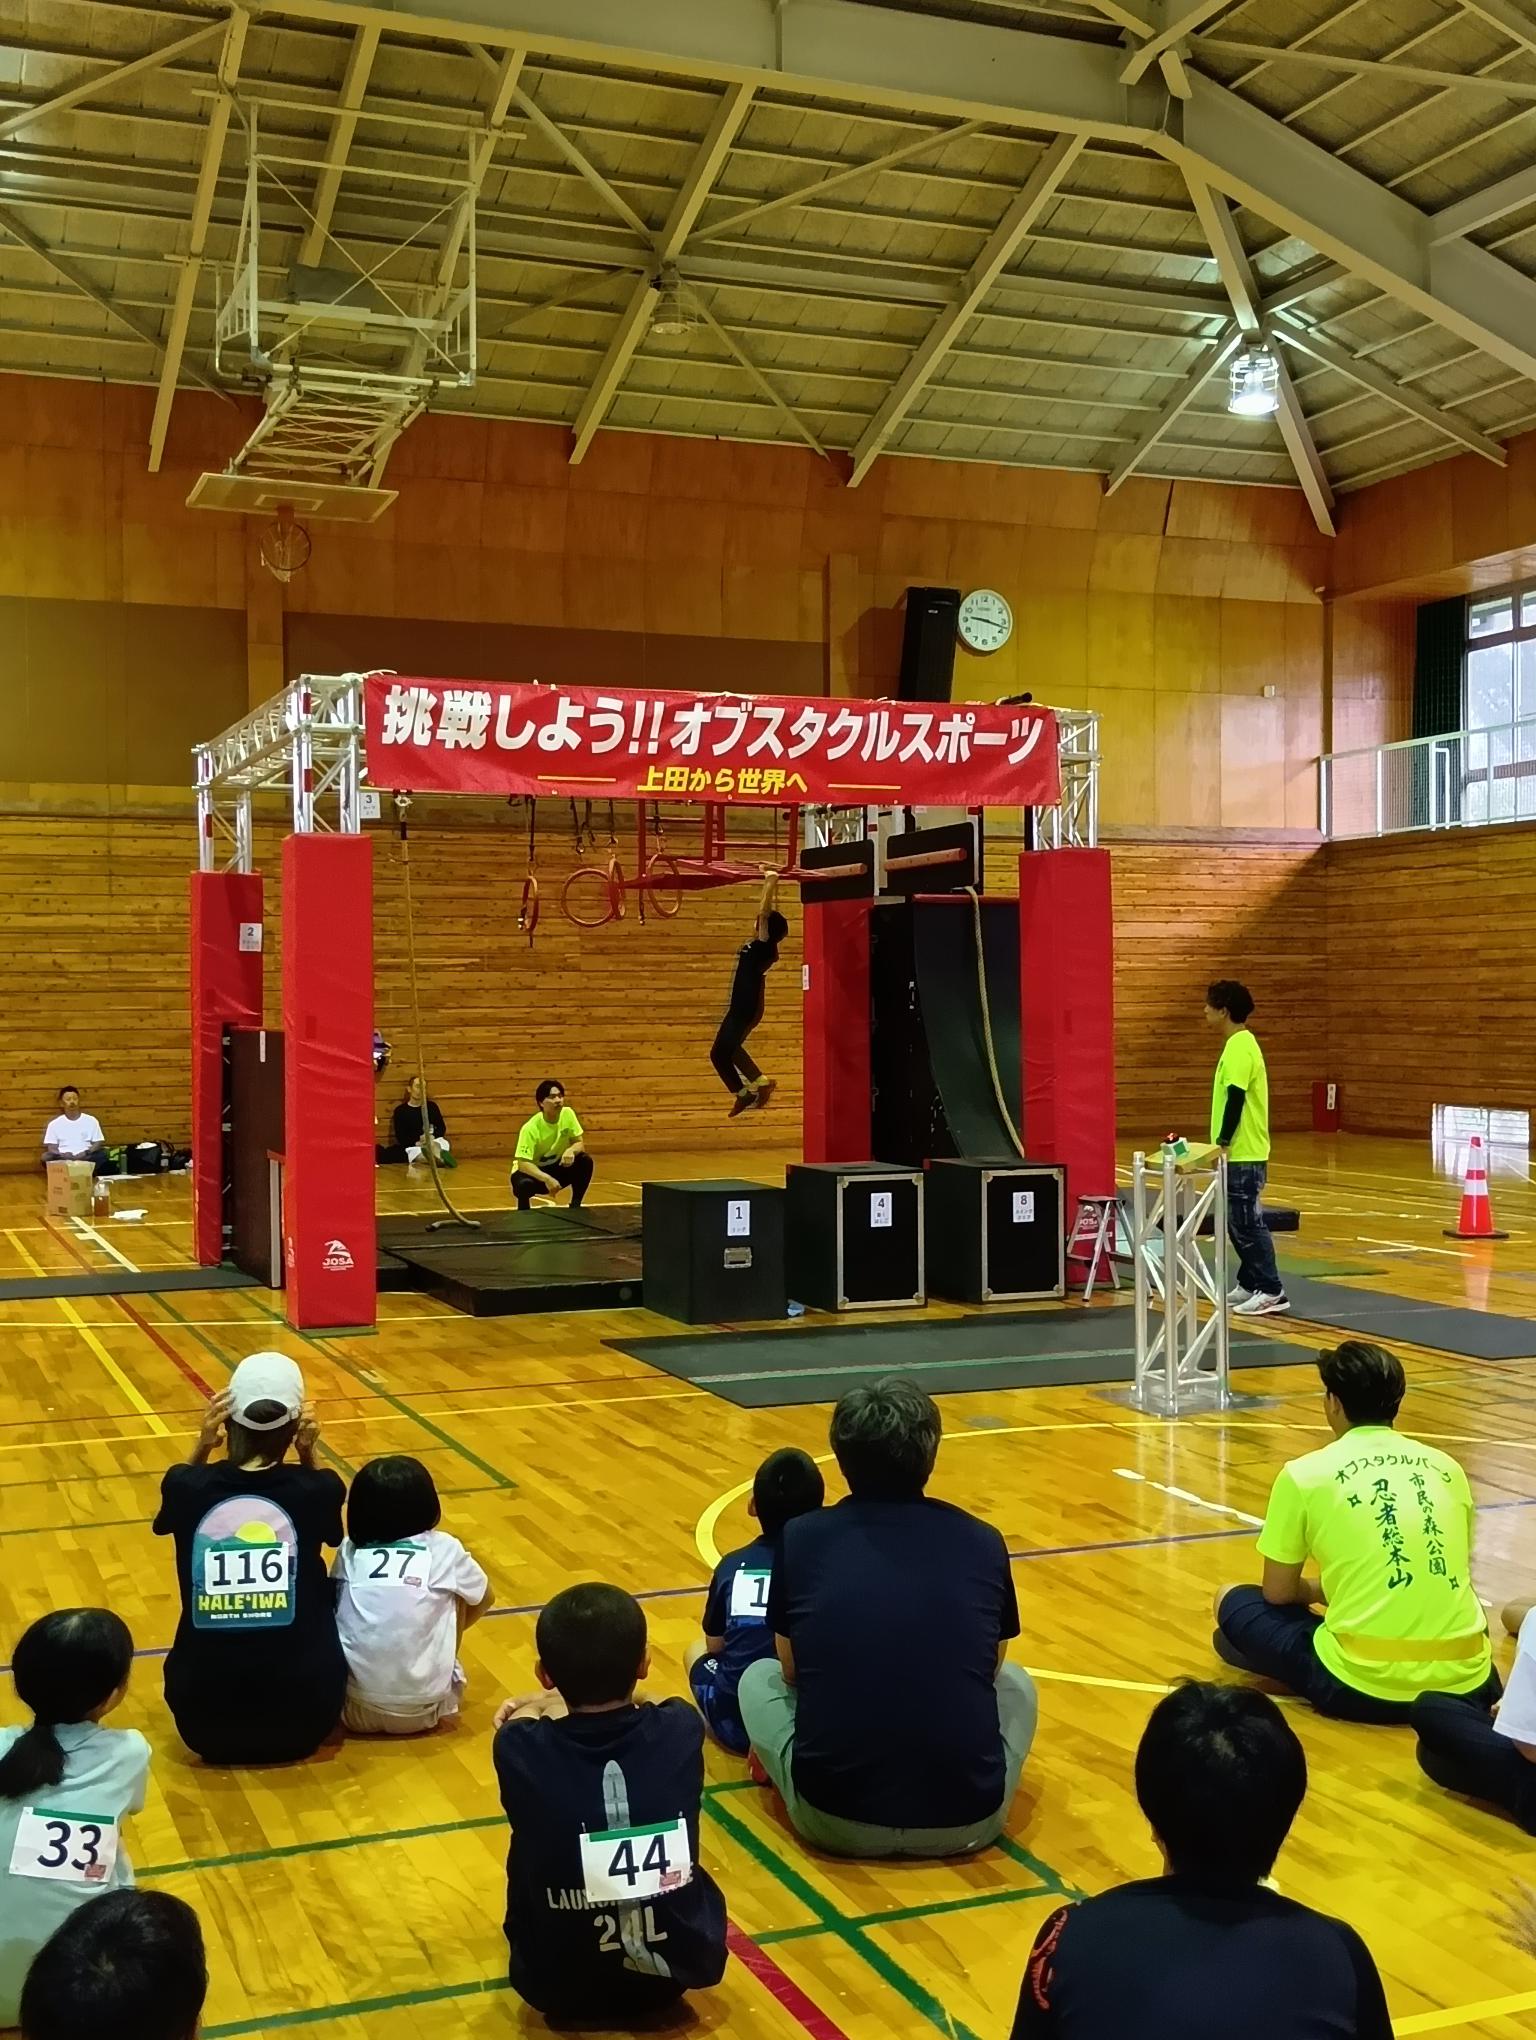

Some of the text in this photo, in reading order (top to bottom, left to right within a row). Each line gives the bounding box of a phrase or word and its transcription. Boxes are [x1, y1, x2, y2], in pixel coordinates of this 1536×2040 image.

[637, 766, 808, 795] 上田から世界へ
[366, 794, 373, 804] 3
[247, 926, 254, 936] 2
[877, 1197, 885, 1208] 4
[1020, 1194, 1028, 1205] 8
[735, 1206, 743, 1219] 1
[322, 1257, 354, 1266] JOSA
[1370, 1478, 1413, 1590] 忍者総本山
[212, 1549, 284, 1587] 116
[369, 1549, 416, 1579] 27
[37, 1820, 102, 1871] 33
[608, 1834, 671, 1887] 44
